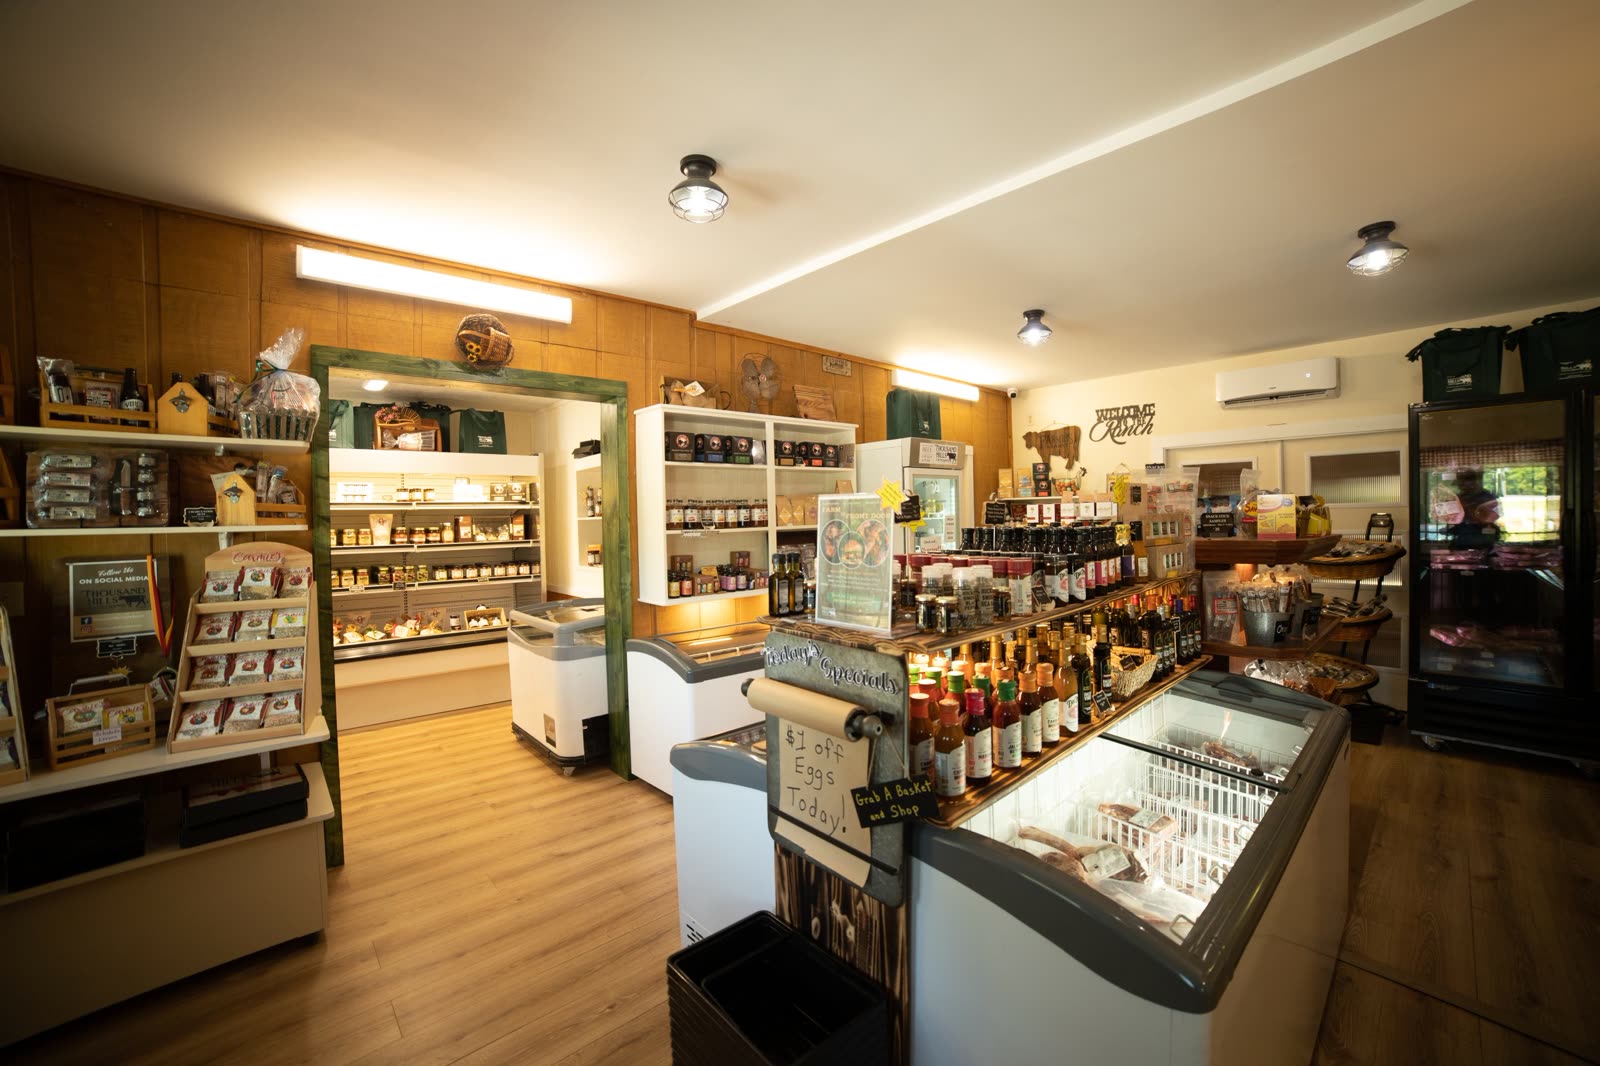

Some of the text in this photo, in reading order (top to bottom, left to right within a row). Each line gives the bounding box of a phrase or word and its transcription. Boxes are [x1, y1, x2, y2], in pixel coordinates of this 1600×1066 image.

[1095, 403, 1156, 421] WELCOME
[1089, 414, 1154, 445] Ranch
[95, 576, 123, 584] SOCIAL
[98, 566, 135, 577] Follow the
[760, 640, 823, 667] Today's
[818, 656, 900, 694] Specials
[785, 726, 844, 763] $1 off
[795, 757, 835, 790] Eggs
[786, 786, 848, 836] Today!
[855, 790, 881, 807] Grab
[884, 788, 893, 800] A
[869, 803, 920, 821] and Shop
